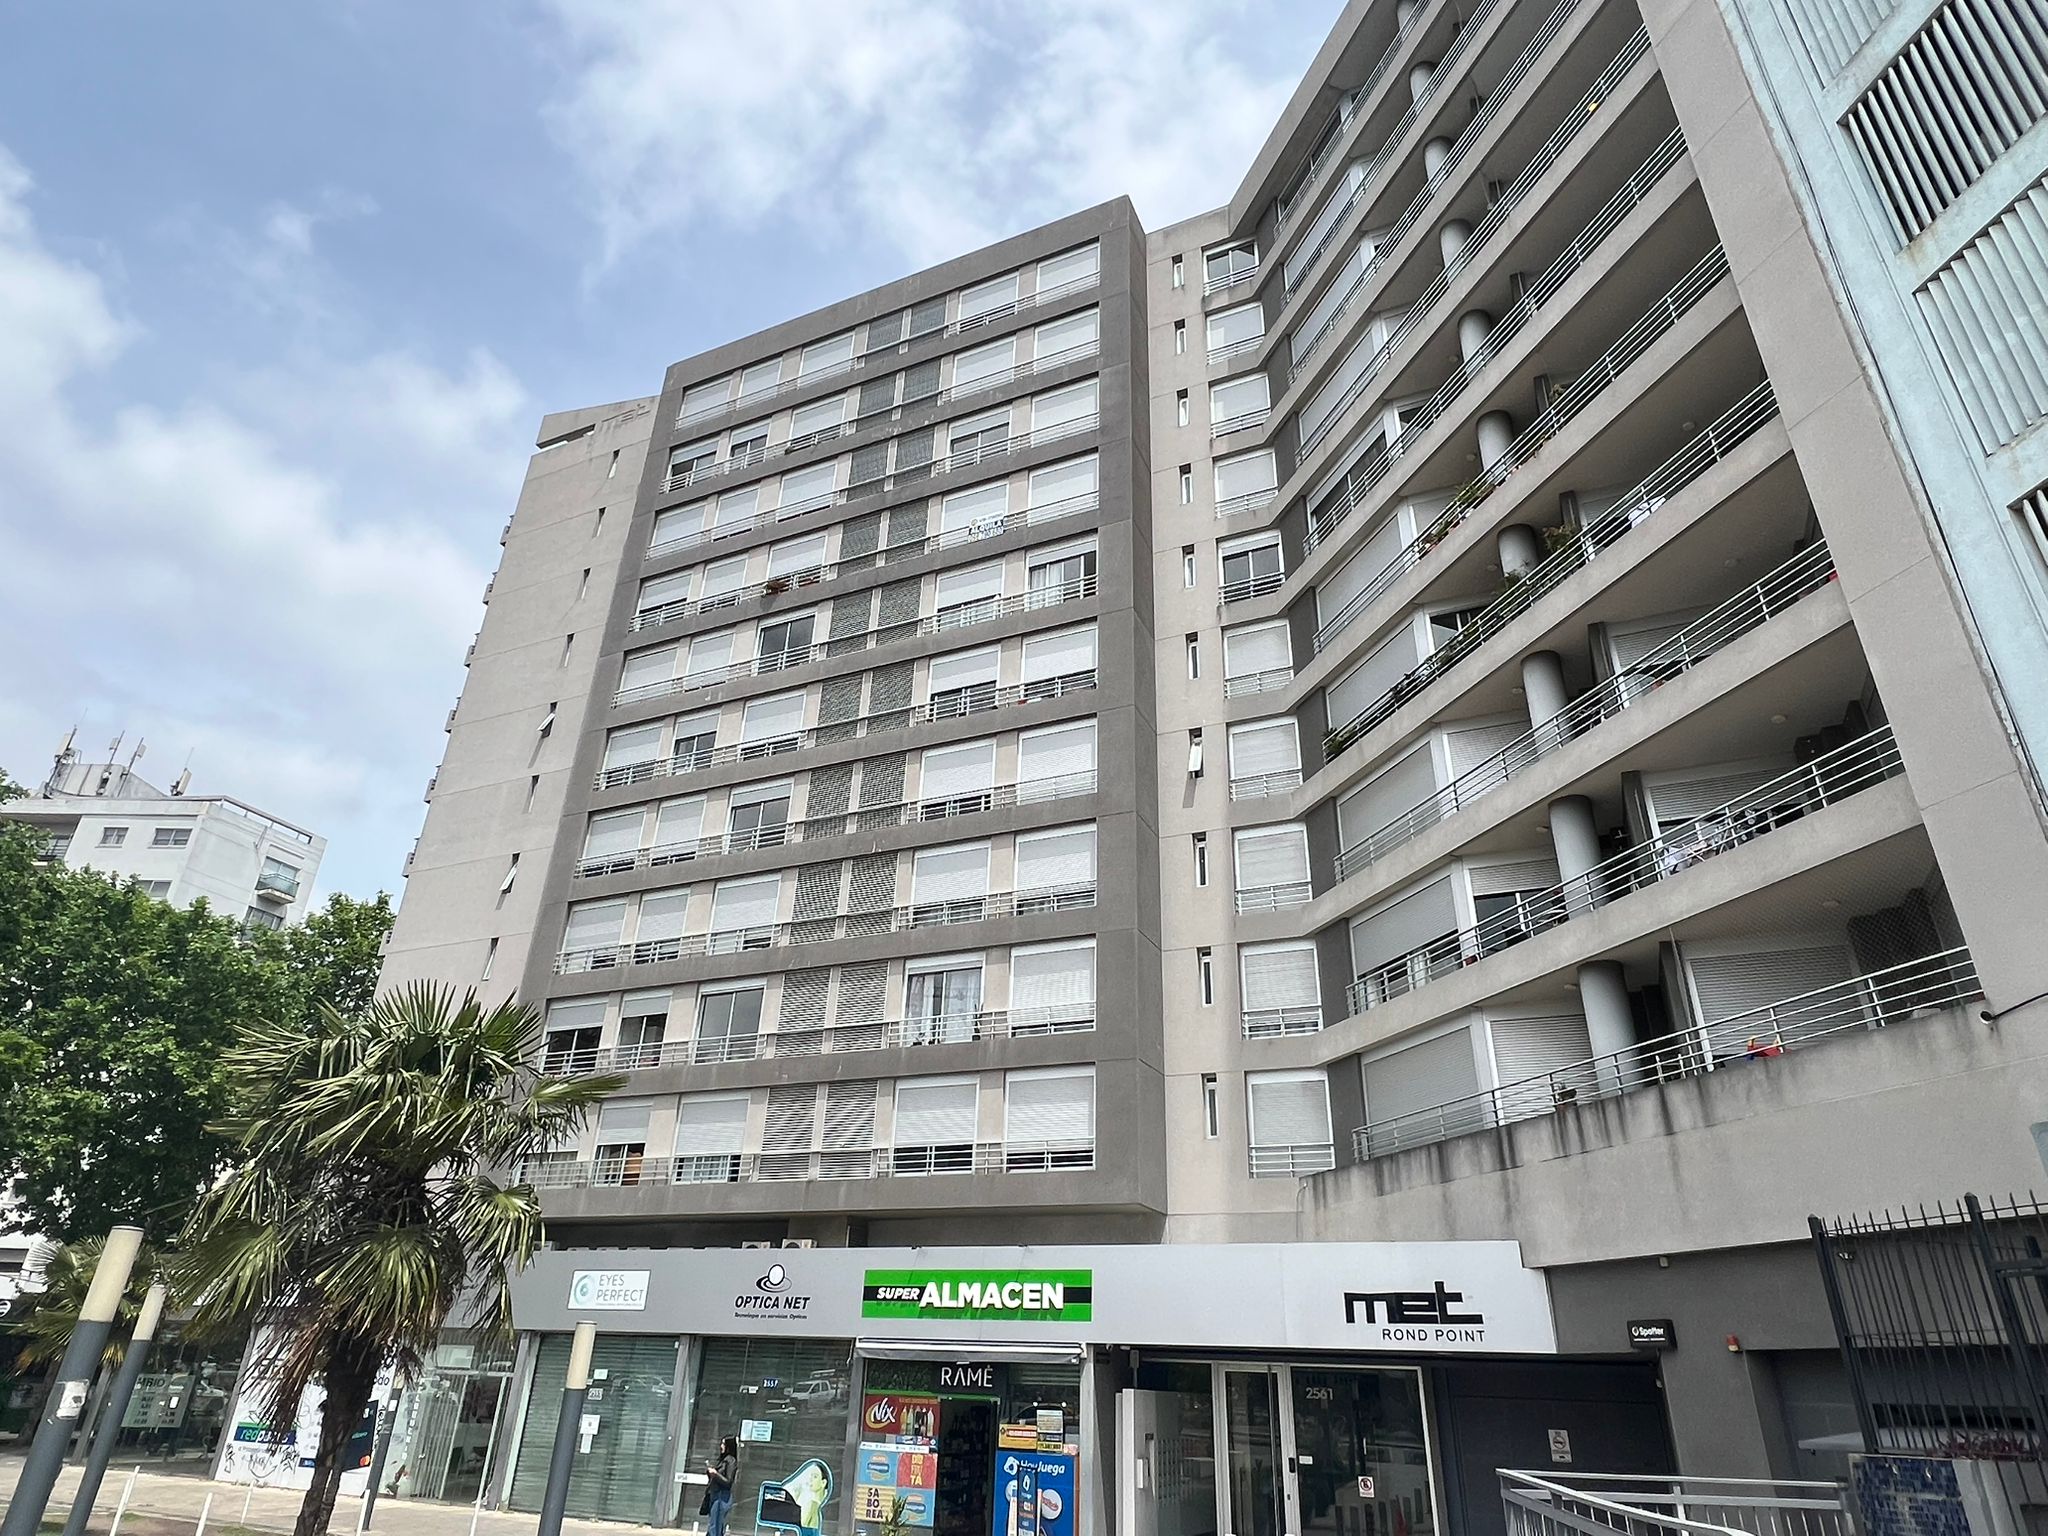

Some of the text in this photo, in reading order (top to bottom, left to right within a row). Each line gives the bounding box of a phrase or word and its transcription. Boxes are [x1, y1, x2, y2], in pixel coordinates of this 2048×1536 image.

[970, 519, 1003, 535] ALQUILA
[599, 1274, 625, 1287] EYES
[596, 1289, 645, 1301] PERFECT
[877, 1282, 1064, 1309] SUPER ALMACEN
[735, 1295, 811, 1310] OPTICA NET
[1344, 1281, 1484, 1324] met
[1382, 1328, 1485, 1342] ROND POINT
[1306, 1387, 1334, 1400] 2561
[867, 1487, 880, 1498] SA
[866, 1498, 880, 1508] BO
